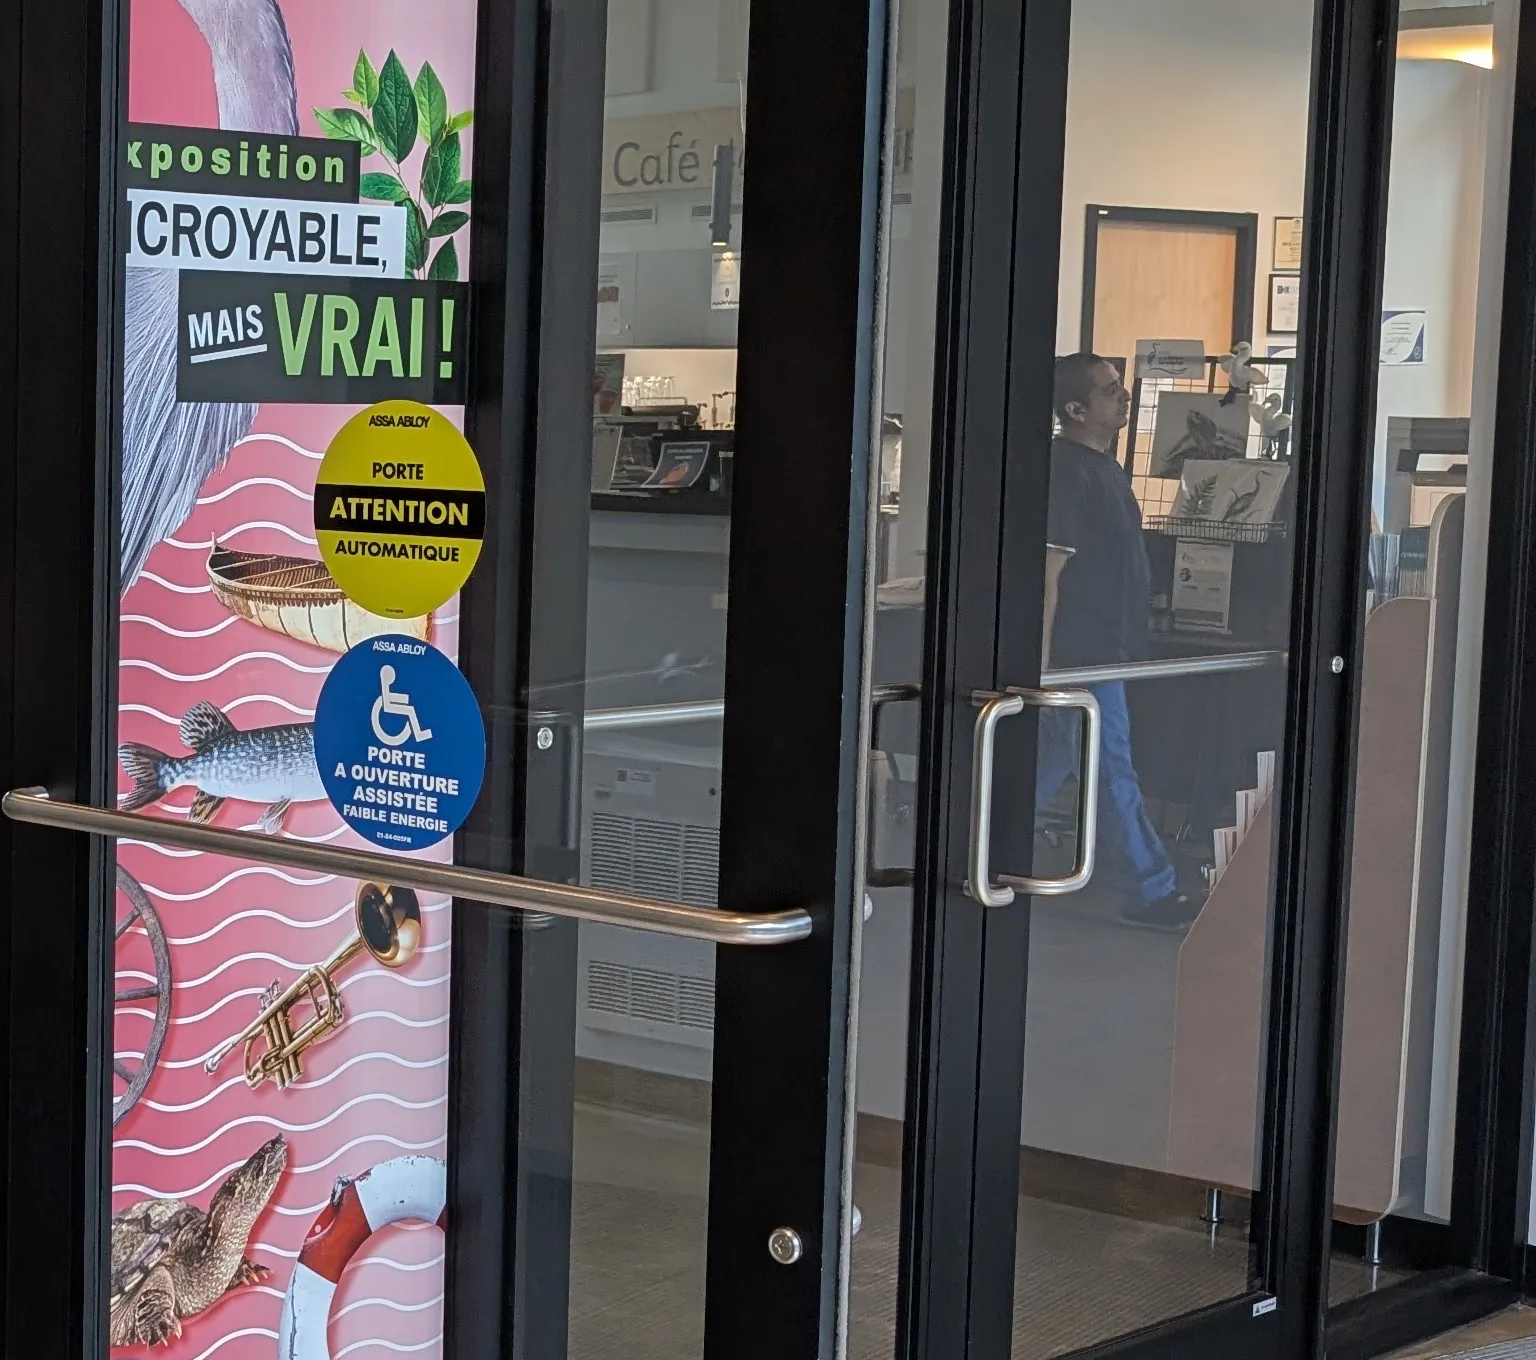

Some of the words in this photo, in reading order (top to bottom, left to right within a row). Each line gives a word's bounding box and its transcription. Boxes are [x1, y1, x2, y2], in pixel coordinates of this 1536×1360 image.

[127, 141, 345, 183] xposition
[613, 131, 700, 187] Café
[126, 200, 388, 273] CROYABLE,
[187, 304, 264, 349] MAIS
[273, 292, 424, 378] VRAI
[368, 415, 395, 428] ASSA
[396, 415, 431, 429] ABLOY
[371, 461, 424, 480] PORTE
[329, 496, 469, 526] ATTENTION
[334, 539, 460, 563] AUTOMATIQUE
[372, 640, 396, 653] ASSA
[397, 643, 427, 656] ABLOY
[367, 745, 426, 770] PORTE
[333, 762, 347, 778] A
[351, 764, 460, 796] OUVERTURE
[352, 785, 438, 814] ASSISTÉE
[342, 803, 387, 823] FAIBLE
[390, 811, 448, 833] ENERGIE
